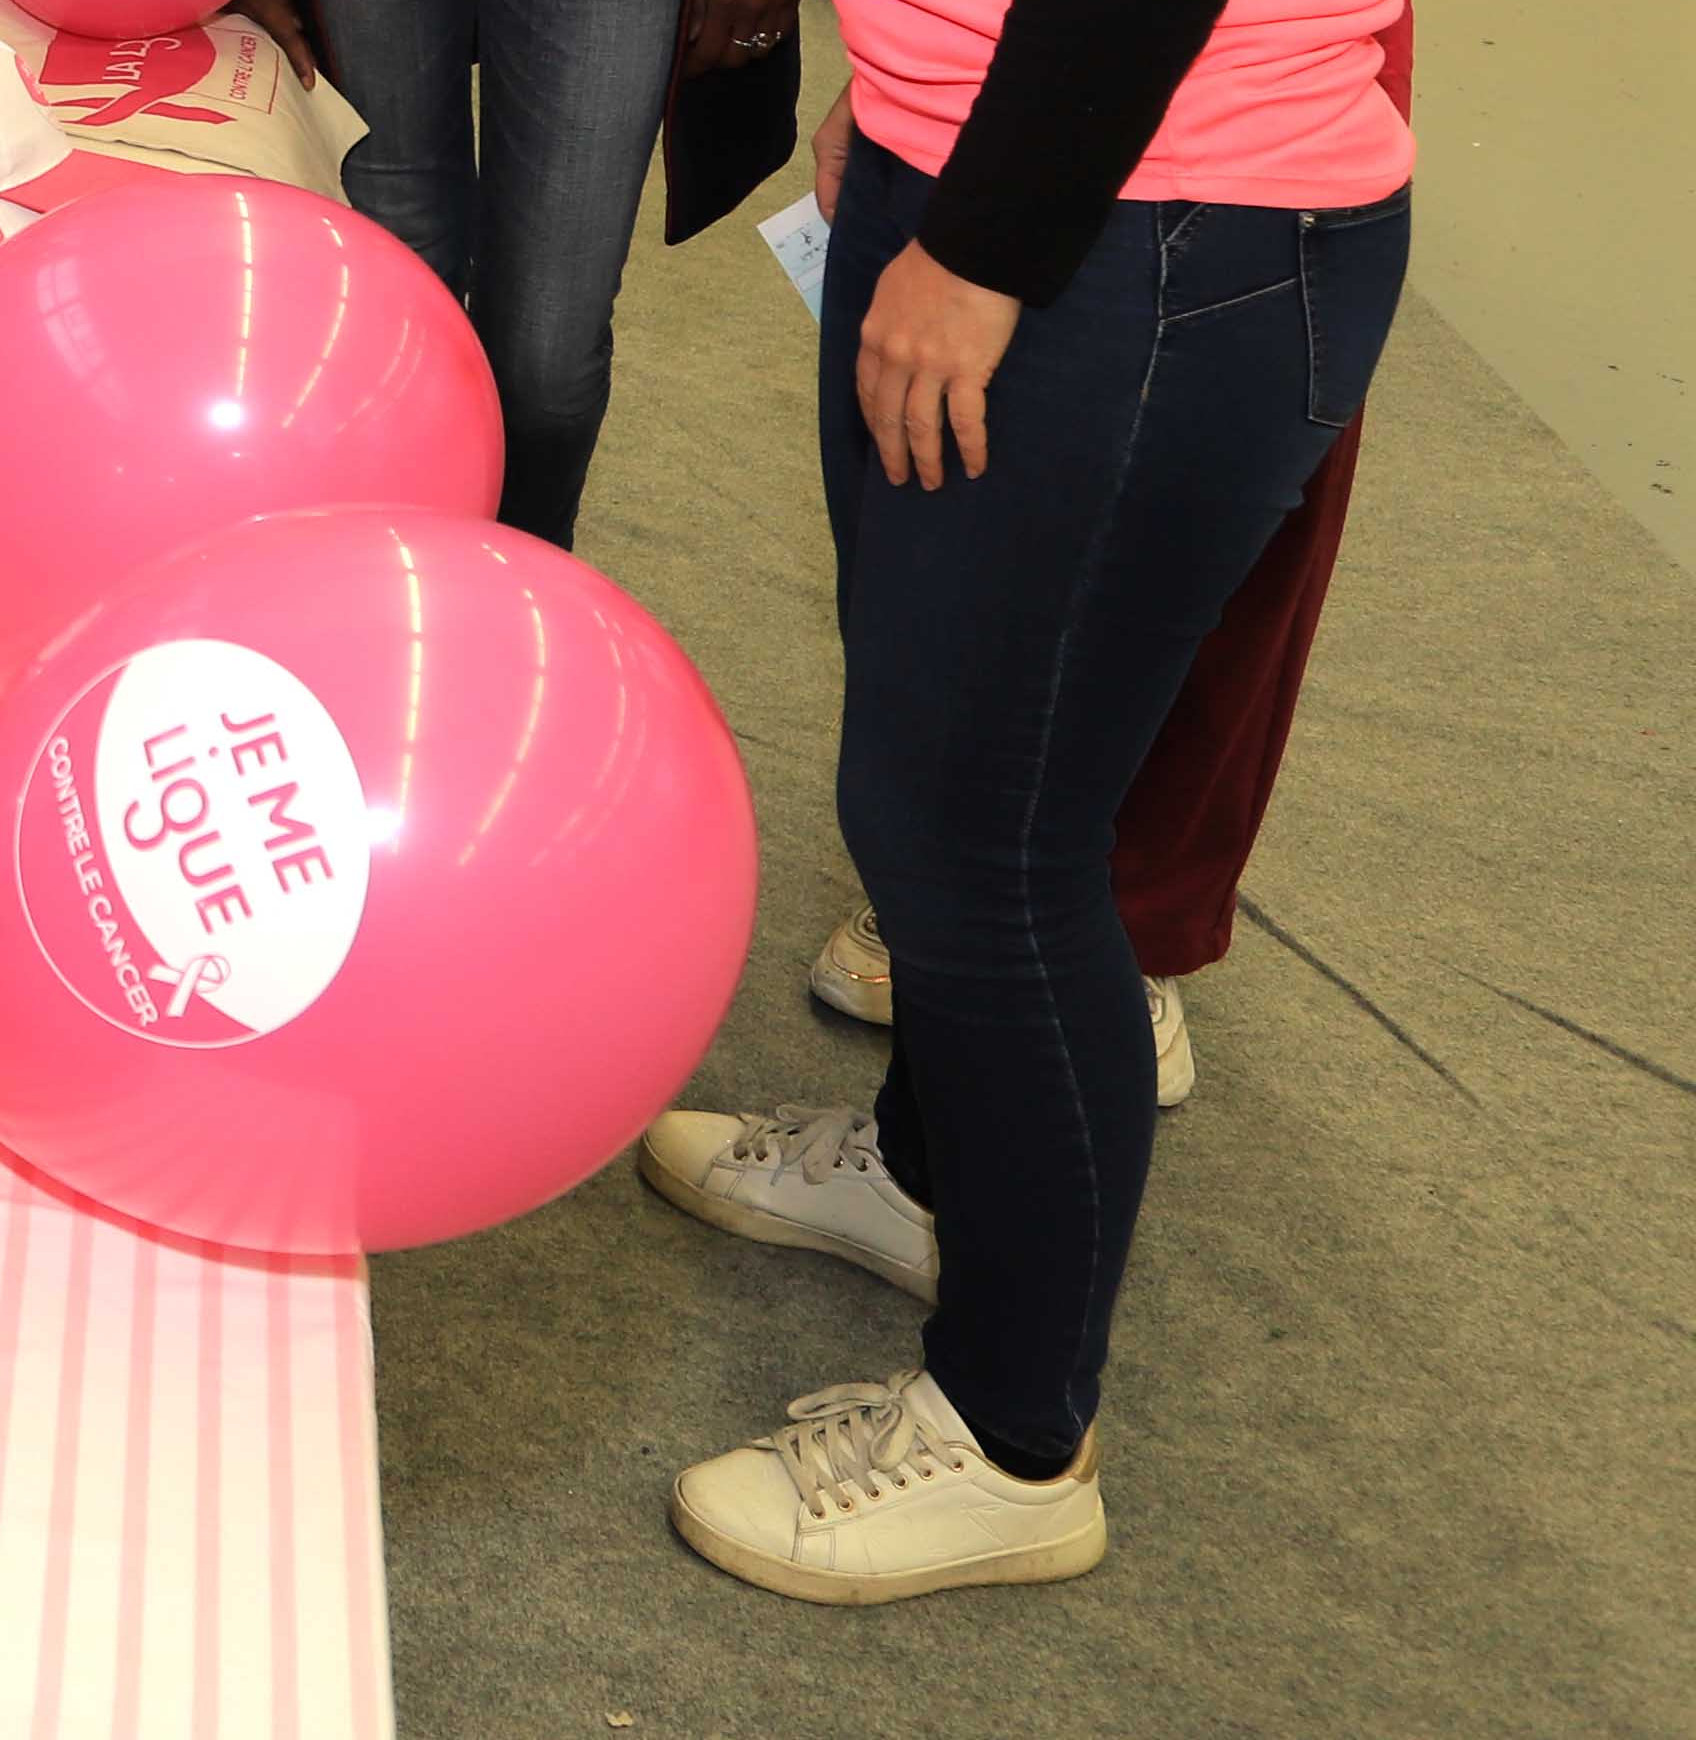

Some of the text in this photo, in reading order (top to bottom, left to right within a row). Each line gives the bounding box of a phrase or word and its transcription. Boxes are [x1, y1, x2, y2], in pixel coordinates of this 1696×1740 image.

[102, 60, 144, 81] LA
[46, 735, 161, 1029] CONTRE LE CANCER
[219, 711, 336, 896] JE ME
